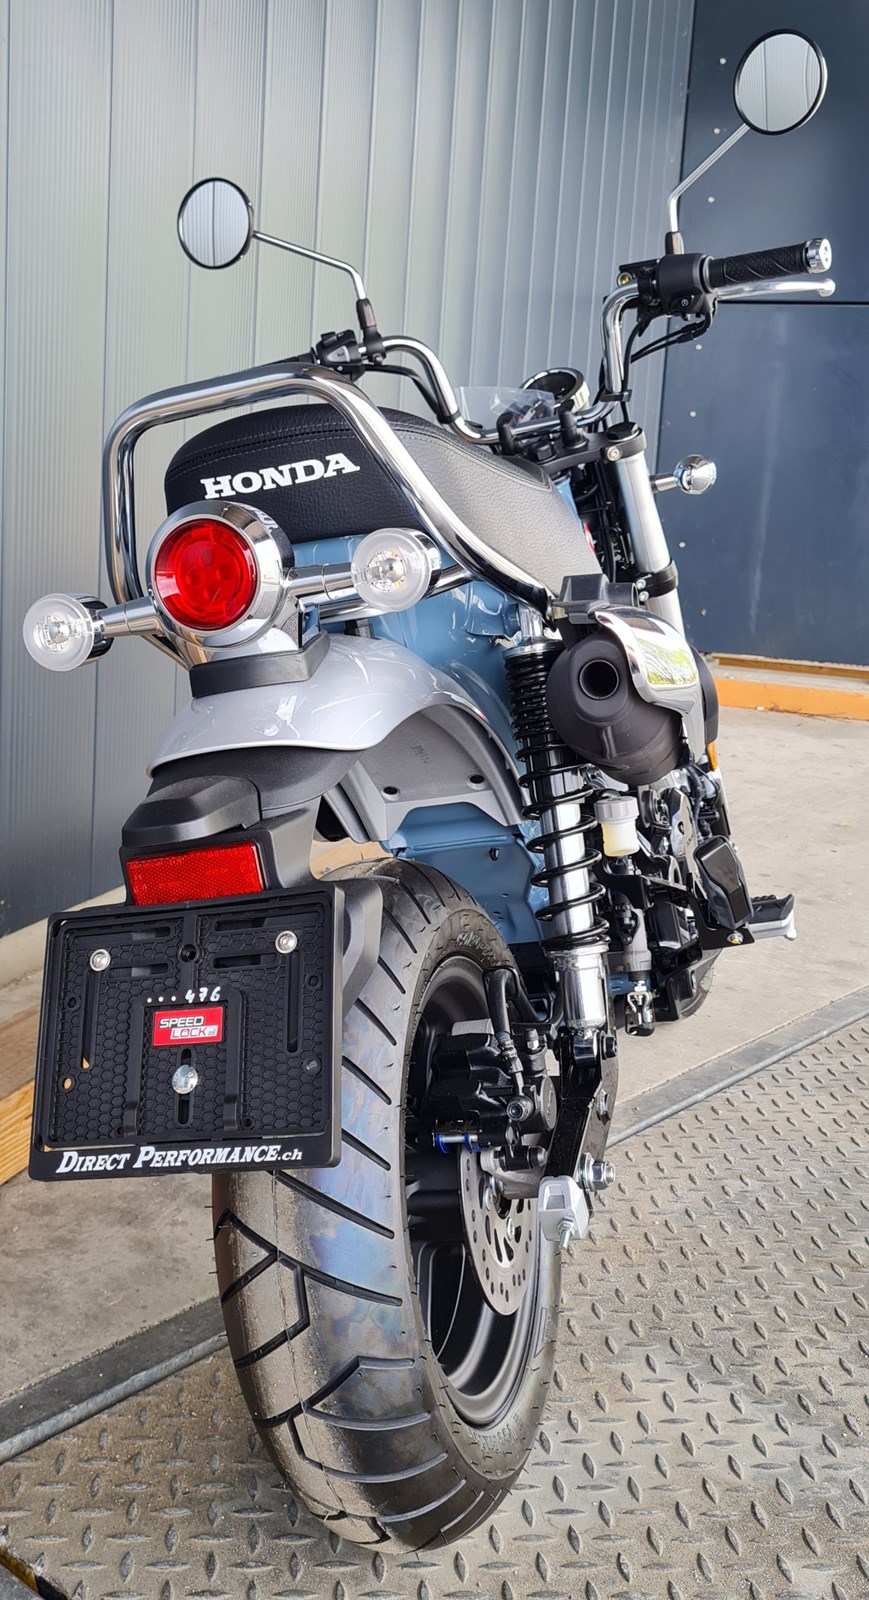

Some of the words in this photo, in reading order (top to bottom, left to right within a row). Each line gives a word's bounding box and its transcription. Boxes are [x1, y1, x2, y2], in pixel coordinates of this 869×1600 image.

[200, 453, 360, 499] HONDA
[159, 1016, 204, 1028] SPEED
[172, 1027, 207, 1038] LOCK
[55, 1151, 131, 1173] DIRECT
[132, 1145, 302, 1168] PERFORMANCE.ch
